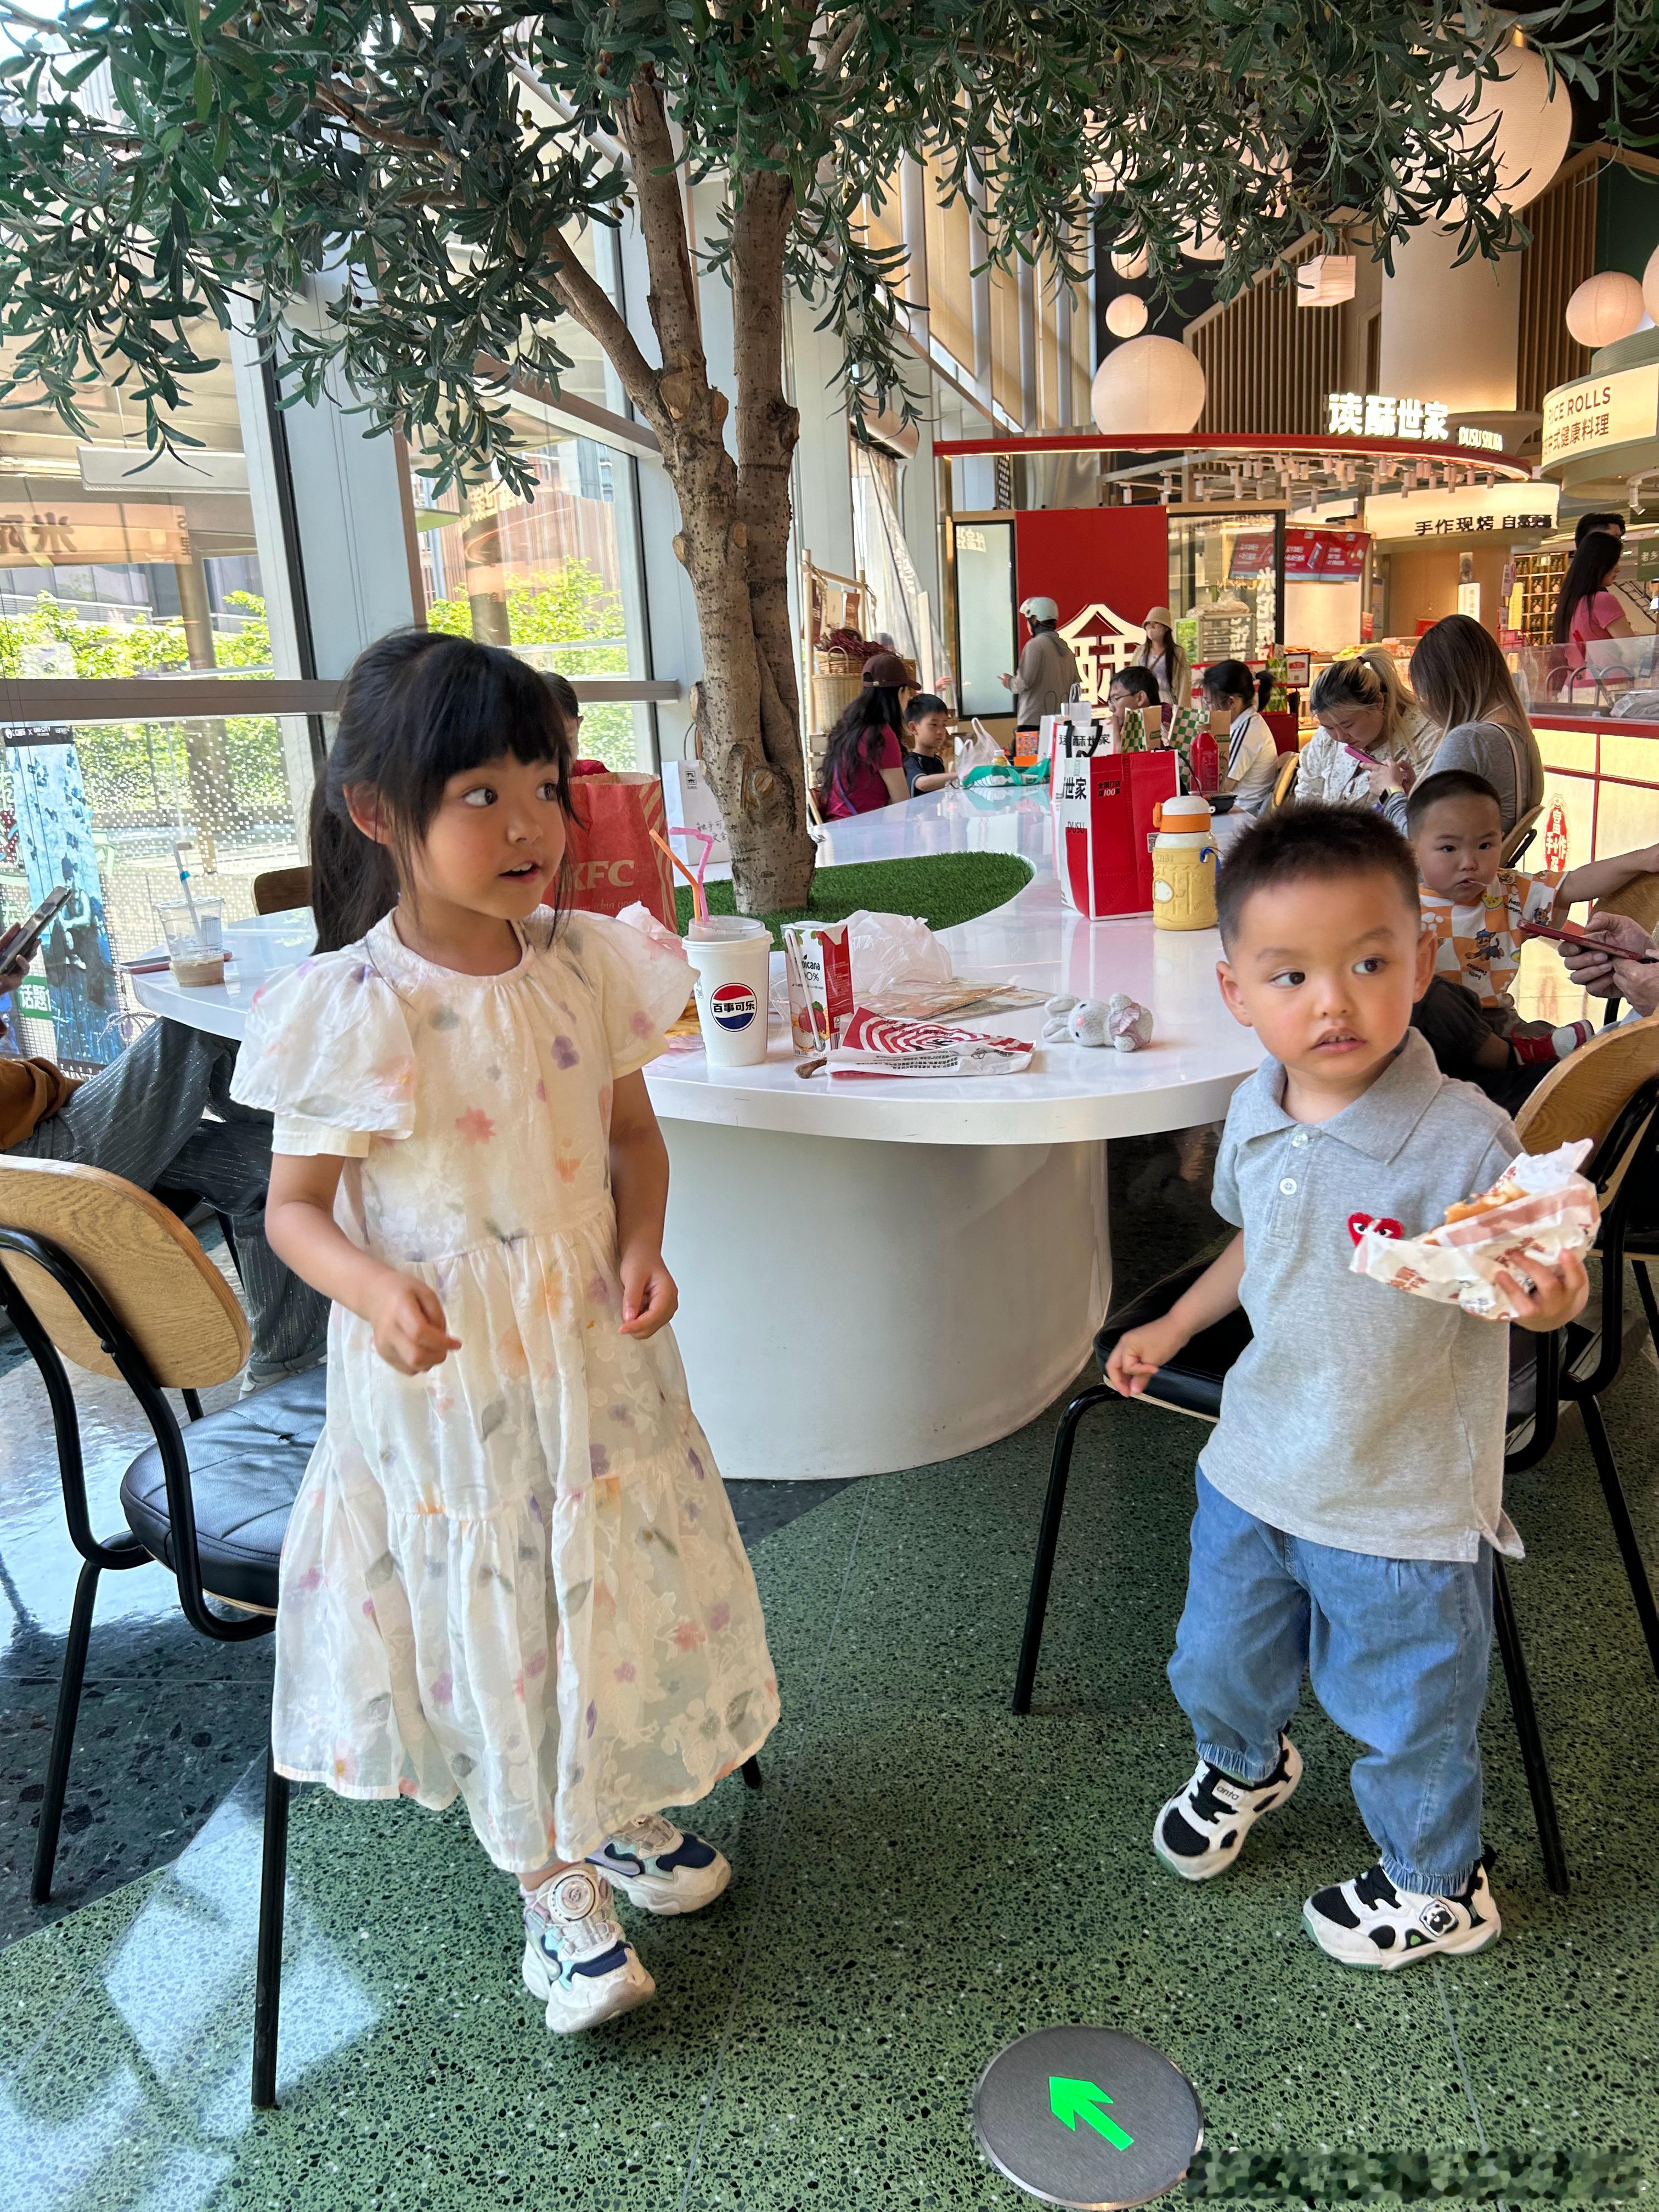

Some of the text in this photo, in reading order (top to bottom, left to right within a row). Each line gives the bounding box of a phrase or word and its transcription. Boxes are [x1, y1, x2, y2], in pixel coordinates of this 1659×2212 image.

[1567, 386, 1611, 416] ROLLS
[1328, 392, 1449, 441] 读酥世家
[1415, 516, 1493, 535] 手作现烤
[561, 860, 635, 892] KFC
[713, 1000, 755, 1013] 百事可乐
[1217, 1786, 1239, 1800] anta
